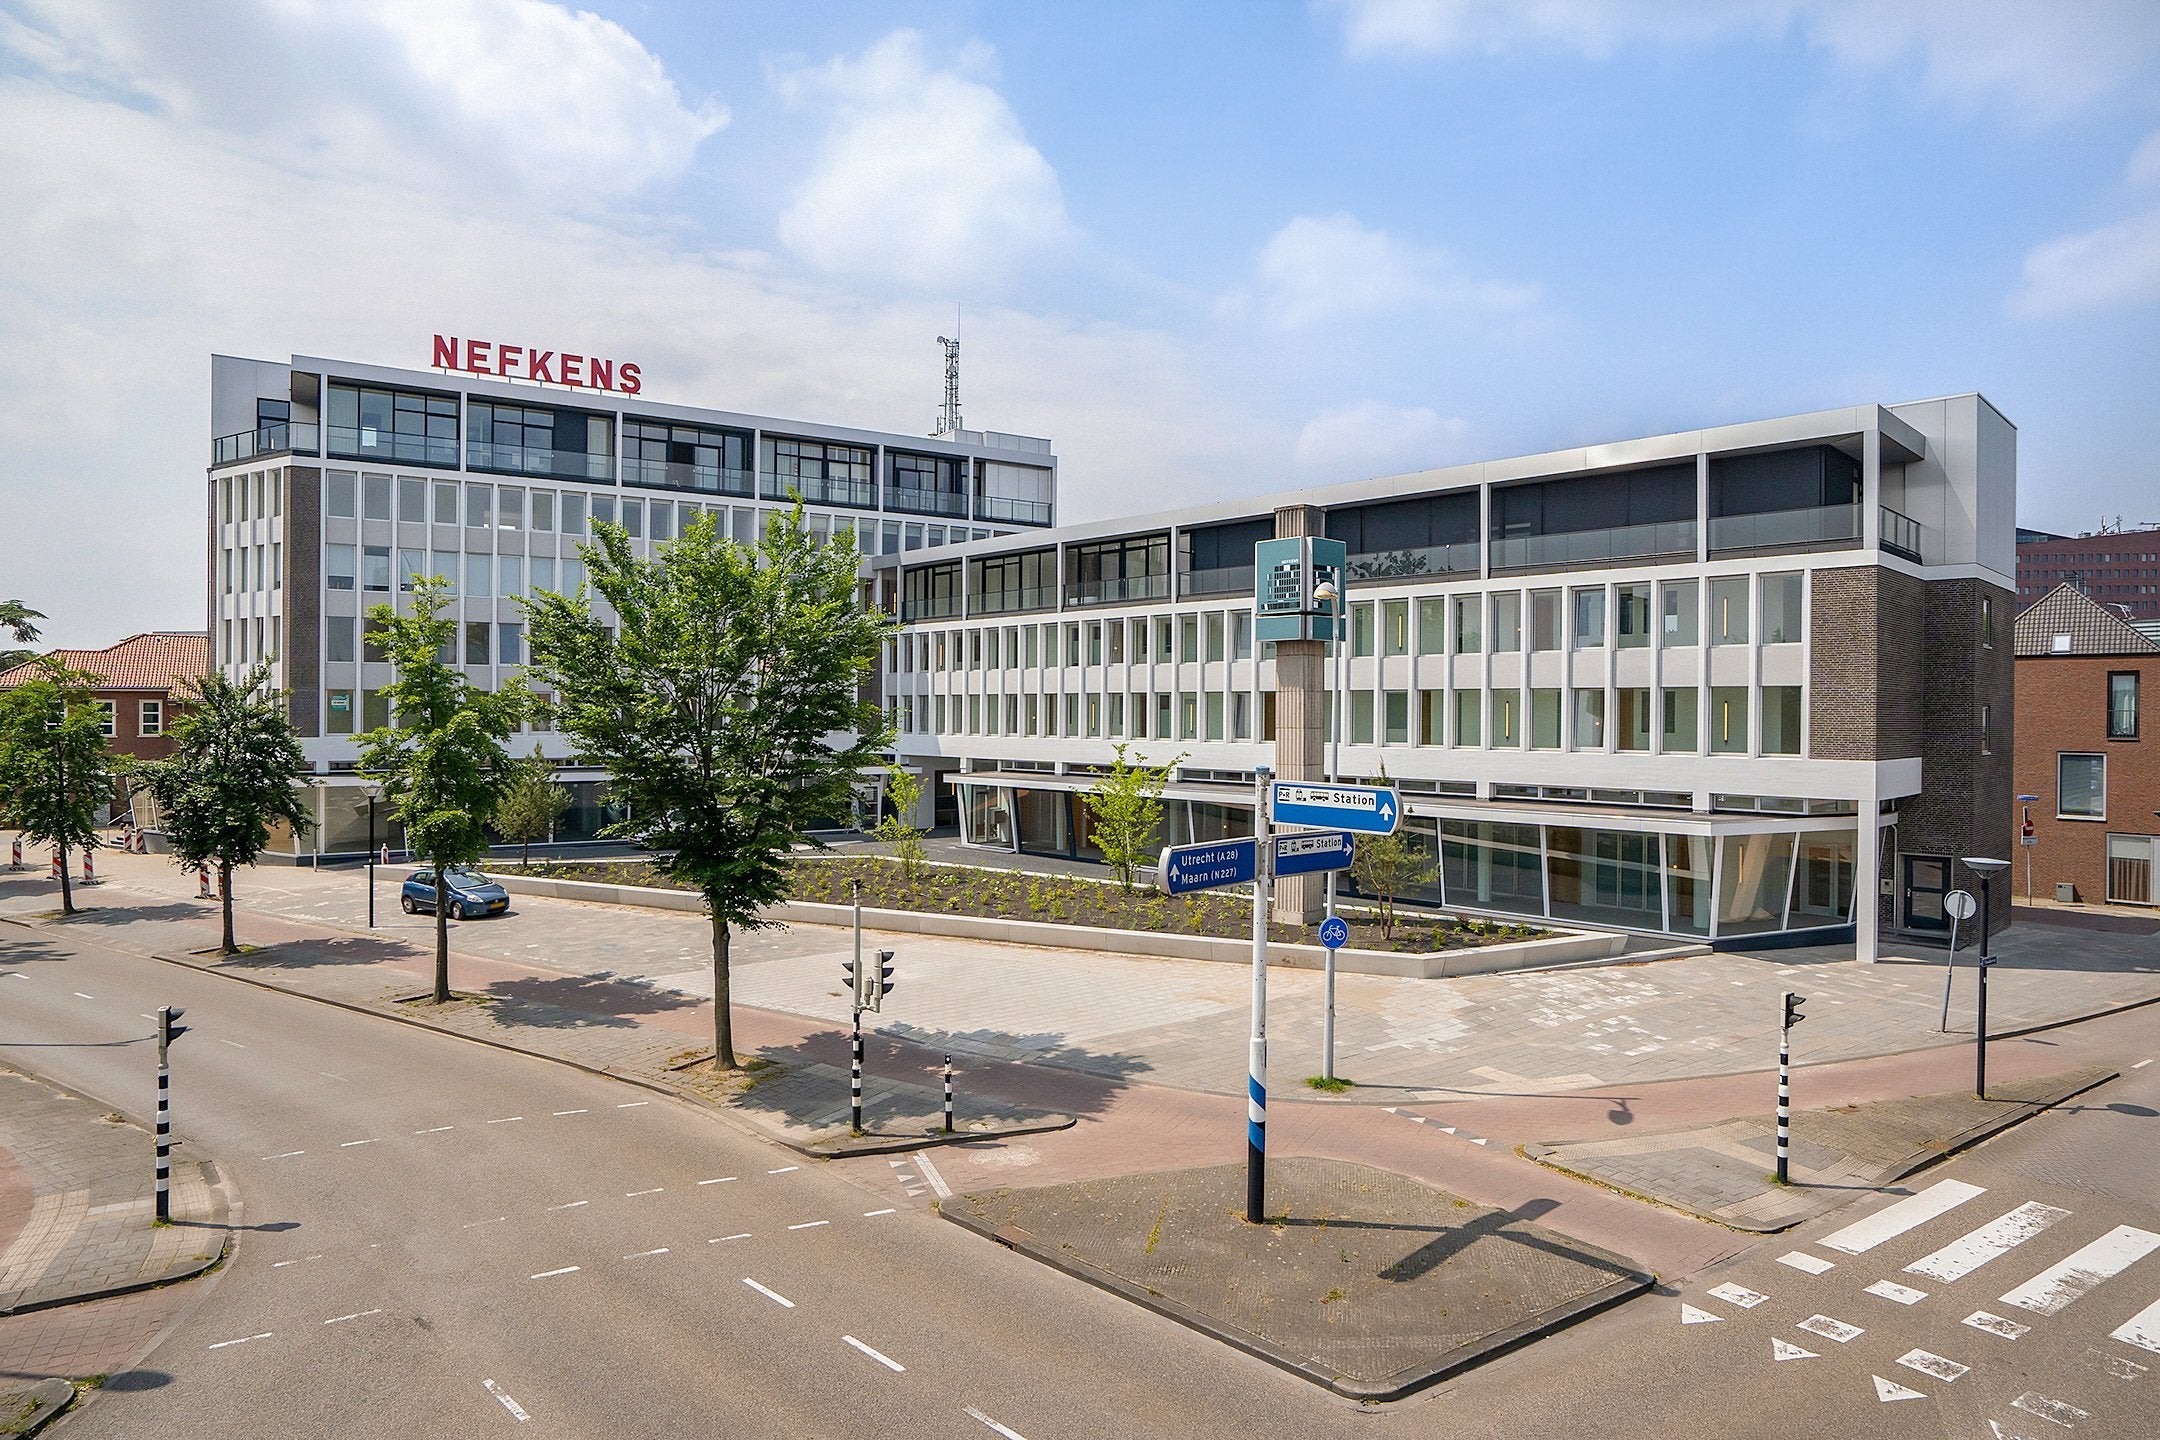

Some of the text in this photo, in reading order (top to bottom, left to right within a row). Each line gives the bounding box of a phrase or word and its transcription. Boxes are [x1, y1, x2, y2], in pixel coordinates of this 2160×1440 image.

[433, 334, 642, 394] NEFKENS
[1333, 792, 1375, 806] Station
[1316, 837, 1342, 849] Station
[1181, 852, 1215, 867] Utrecht
[1181, 872, 1208, 885] Maarn
